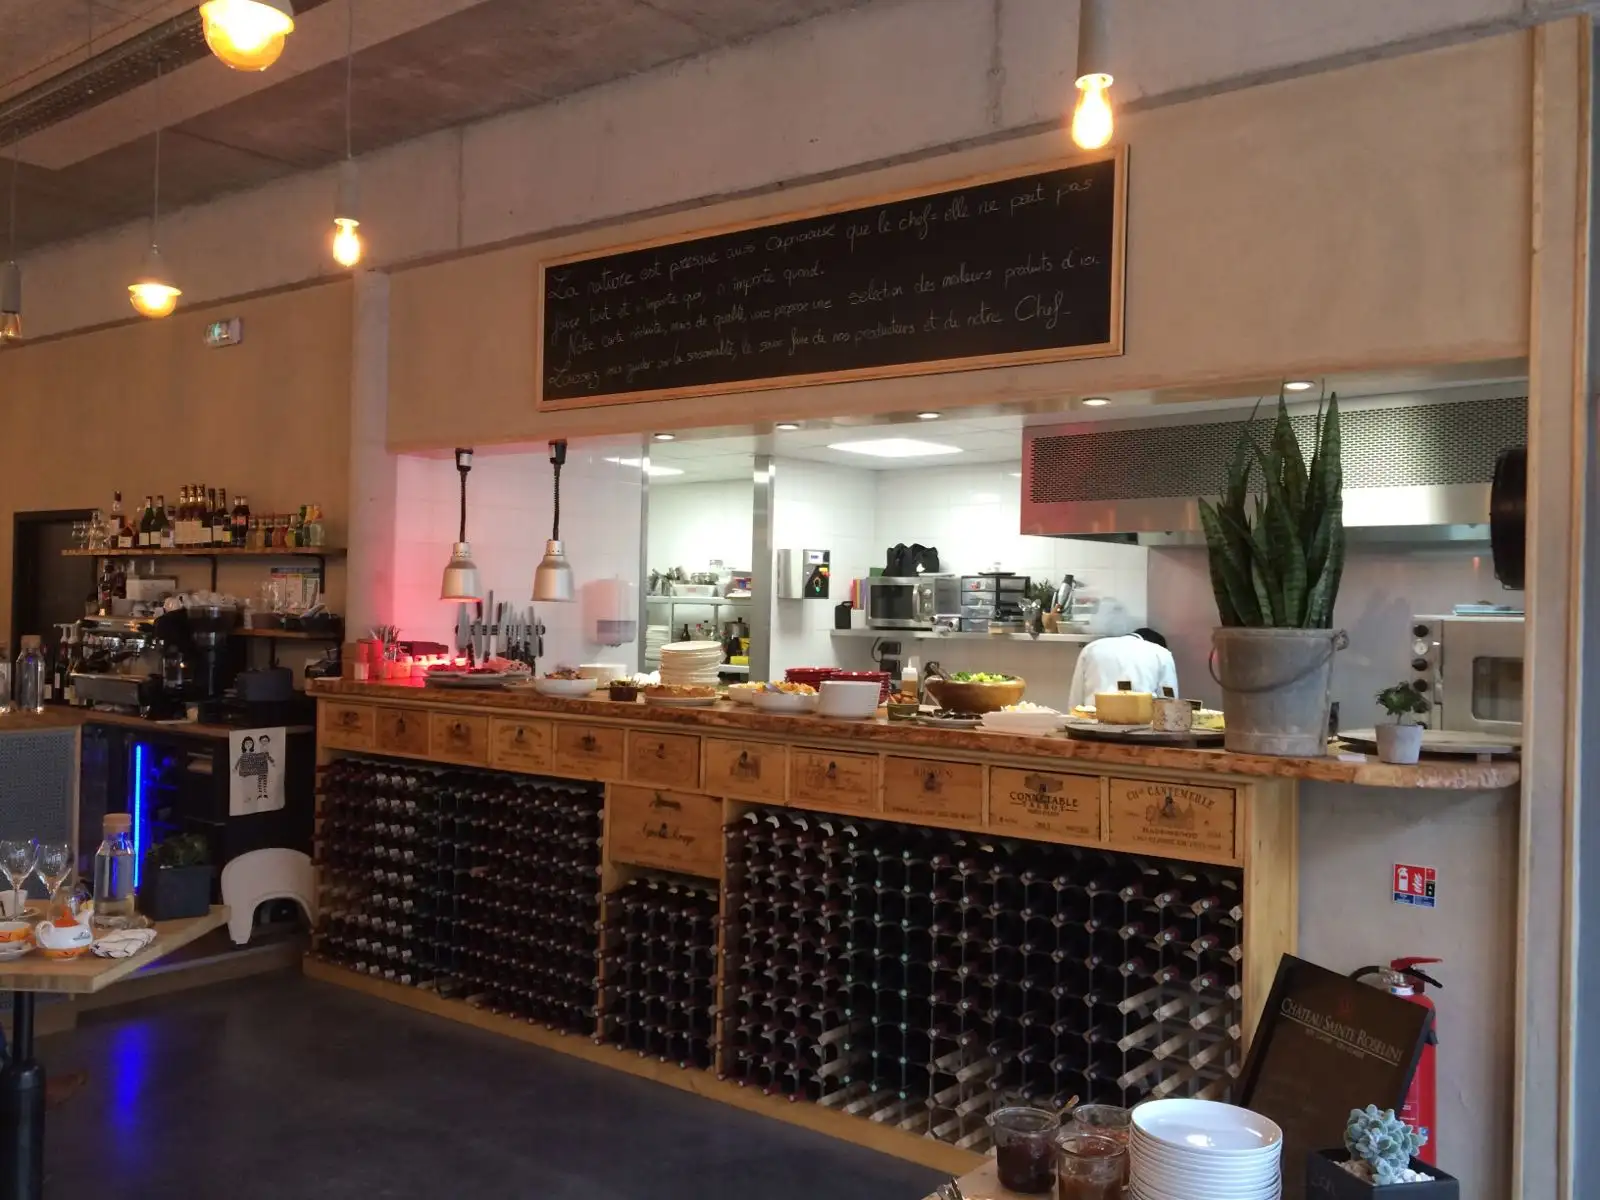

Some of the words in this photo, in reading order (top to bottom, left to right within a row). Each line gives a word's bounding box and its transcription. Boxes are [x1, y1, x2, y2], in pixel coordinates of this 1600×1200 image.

[548, 271, 580, 300] La
[588, 266, 635, 297] nature
[640, 254, 662, 281] est
[669, 251, 720, 281] presque
[846, 224, 872, 254] que
[878, 210, 892, 234] le
[945, 195, 971, 222] elle
[977, 200, 1001, 215] ne
[1010, 182, 1048, 218] peut
[1056, 179, 1094, 206] pas
[695, 313, 708, 329] de
[774, 303, 810, 322] propose
[812, 299, 834, 311] une
[914, 271, 936, 294] des
[1005, 250, 1053, 290] produits
[589, 299, 613, 324] tout
[617, 295, 632, 319] et
[812, 328, 827, 345] de
[832, 332, 851, 343] nos
[854, 311, 916, 349] producteurs
[923, 308, 941, 332] et
[944, 308, 960, 329] de
[968, 300, 1005, 328] notre
[1009, 790, 1079, 807] CONNTABLE
[1147, 785, 1216, 810] CANTEMERLE
